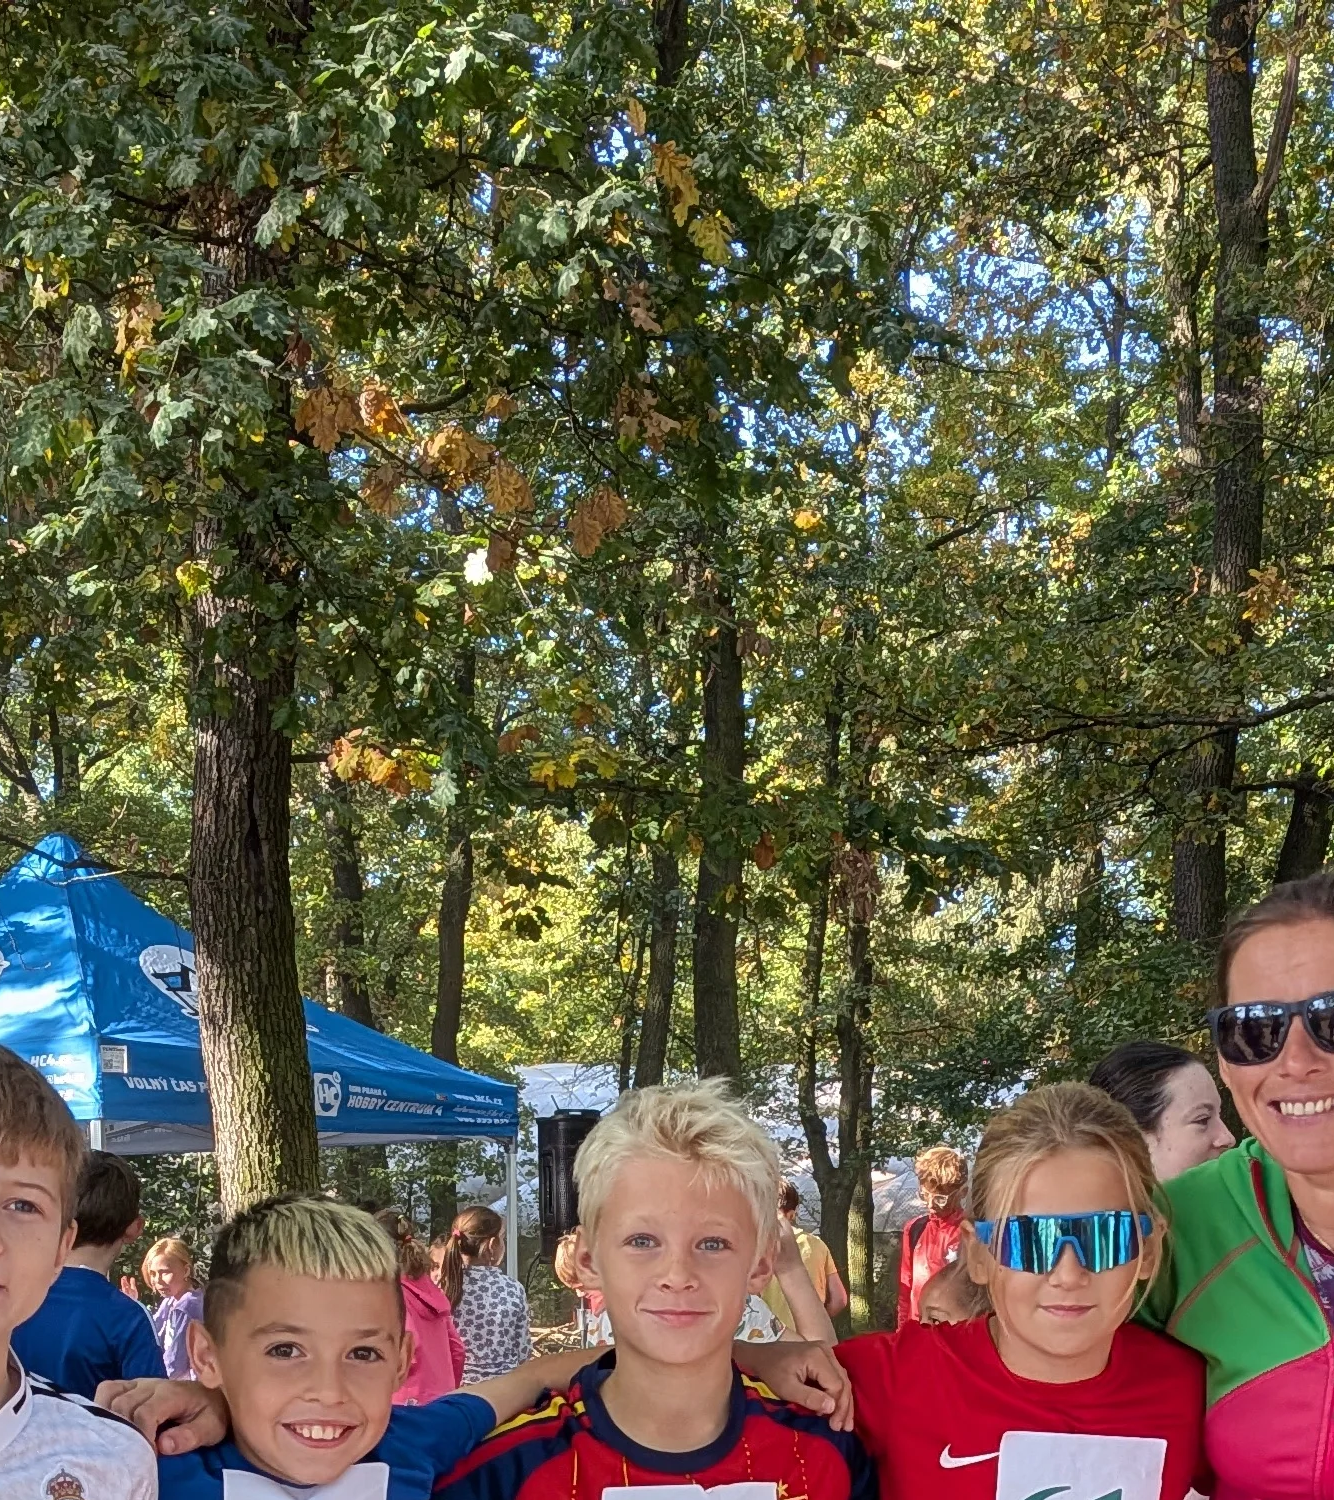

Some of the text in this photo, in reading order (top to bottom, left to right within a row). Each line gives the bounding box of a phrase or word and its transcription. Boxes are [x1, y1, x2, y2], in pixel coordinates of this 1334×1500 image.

[123, 1075, 168, 1091] VOLNÝ
[171, 1077, 198, 1093] ČAS
[347, 1094, 385, 1111] HOBBY
[384, 1099, 436, 1116] CENTRUM
[435, 1105, 443, 1117] 4
